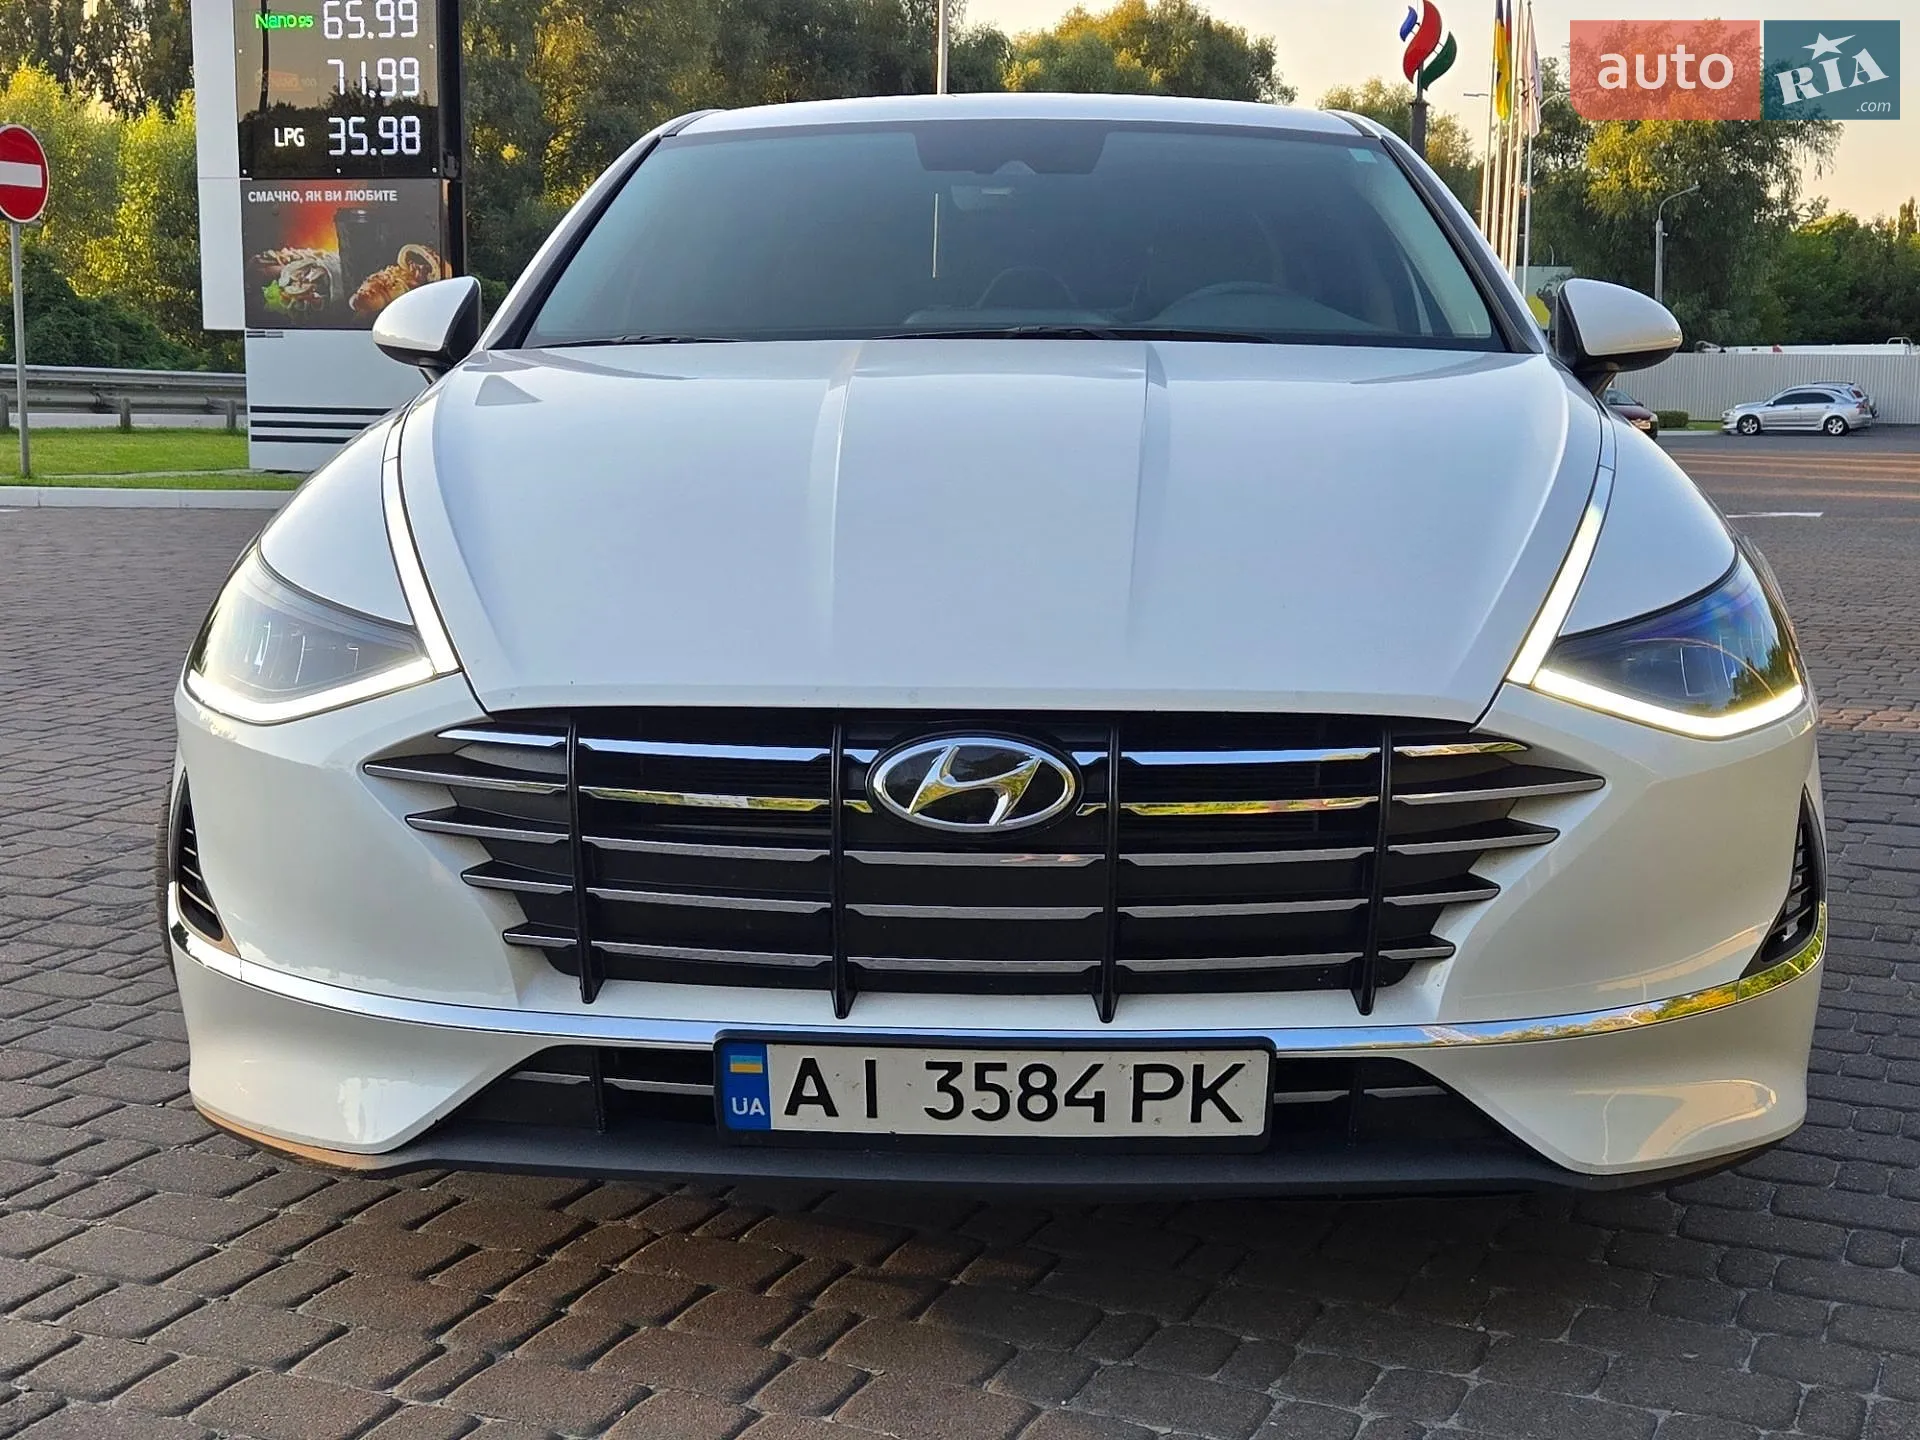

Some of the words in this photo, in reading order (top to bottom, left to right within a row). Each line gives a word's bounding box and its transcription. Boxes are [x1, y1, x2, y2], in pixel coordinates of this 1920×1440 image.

[323, 0, 418, 39] 65.99
[327, 57, 420, 97] 71.99
[274, 127, 305, 147] LPG
[328, 115, 422, 156] 35.98
[248, 190, 303, 204] СМАЧНО,
[305, 190, 322, 202] ЯК
[324, 190, 342, 202] ВИ
[344, 189, 398, 202] ЛЮБИТЕ
[731, 1097, 766, 1117] UA
[784, 1057, 878, 1119] AI
[924, 1061, 1107, 1123] 3584
[1130, 1063, 1248, 1124] PK
